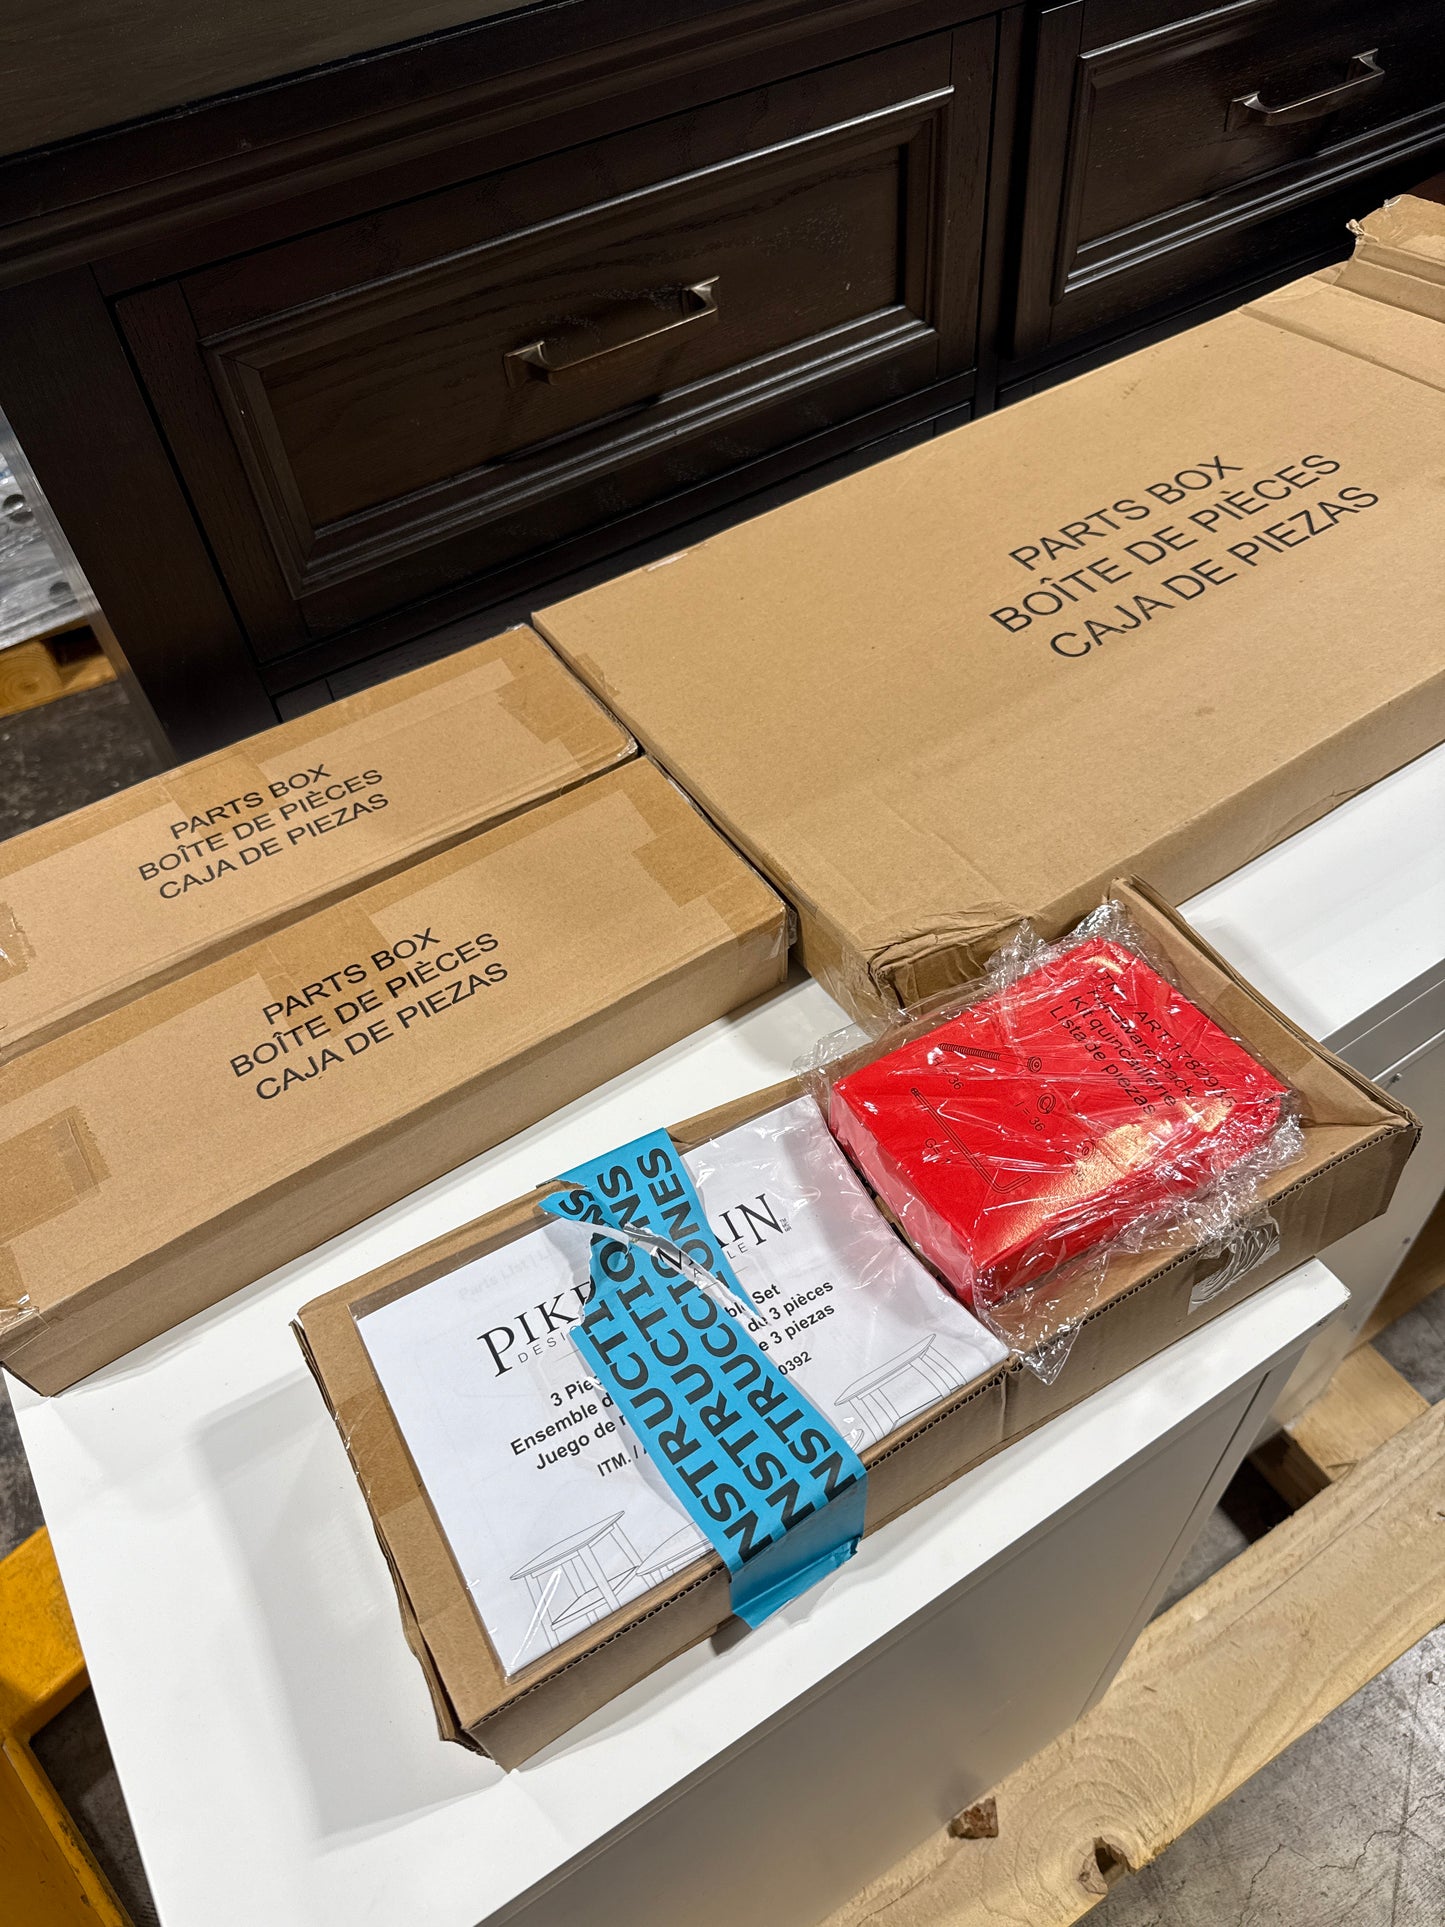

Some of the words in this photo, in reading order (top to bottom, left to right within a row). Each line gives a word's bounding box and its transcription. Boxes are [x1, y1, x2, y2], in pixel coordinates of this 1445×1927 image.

[989, 557, 1132, 633] BOÎTE
[1124, 526, 1198, 565] DE
[1189, 454, 1340, 533] PIÈCES
[1008, 500, 1150, 571] PARTS
[1145, 455, 1244, 505] BOX
[1050, 594, 1176, 658] CAJA
[1162, 559, 1237, 600] DE
[1227, 486, 1379, 566] PIEZAS
[138, 832, 228, 881] BOÎTE
[232, 813, 276, 840] DE
[279, 769, 383, 820] PIÈCES
[159, 859, 238, 899] CAJA
[239, 837, 283, 866] DE
[287, 793, 389, 845] PIEZAS
[170, 792, 264, 839] PARTS
[268, 763, 331, 799] BOX
[230, 1015, 331, 1077] BOÎTE
[334, 989, 383, 1024] DE
[385, 933, 499, 998] PIÈCES
[256, 1048, 345, 1100] CAJA
[344, 1019, 394, 1055] DE
[396, 962, 508, 1029] PIEZAS
[262, 963, 367, 1025] PARTS
[371, 927, 441, 972] BOX
[1069, 996, 1094, 1019] Kit
[1050, 1005, 1087, 1041] Lista
[1085, 1041, 1106, 1061] de
[1101, 1064, 1156, 1115] piezas
[1154, 1057, 1196, 1097] Pack
[1029, 1116, 1045, 1132] 36
[510, 1403, 598, 1456] Ensemble
[769, 1307, 781, 1321] 3
[783, 1281, 834, 1316] pièces
[518, 1332, 567, 1363] DESI
[536, 1434, 590, 1471] Juego
[594, 1420, 616, 1439] de
[770, 1331, 783, 1345] 3
[784, 1305, 835, 1340] piezas
[550, 1392, 563, 1407] 3
[565, 1375, 602, 1400] Pie
[752, 1283, 781, 1305] Set
[597, 1452, 632, 1477] ITM.
[778, 1351, 812, 1376] 0392
